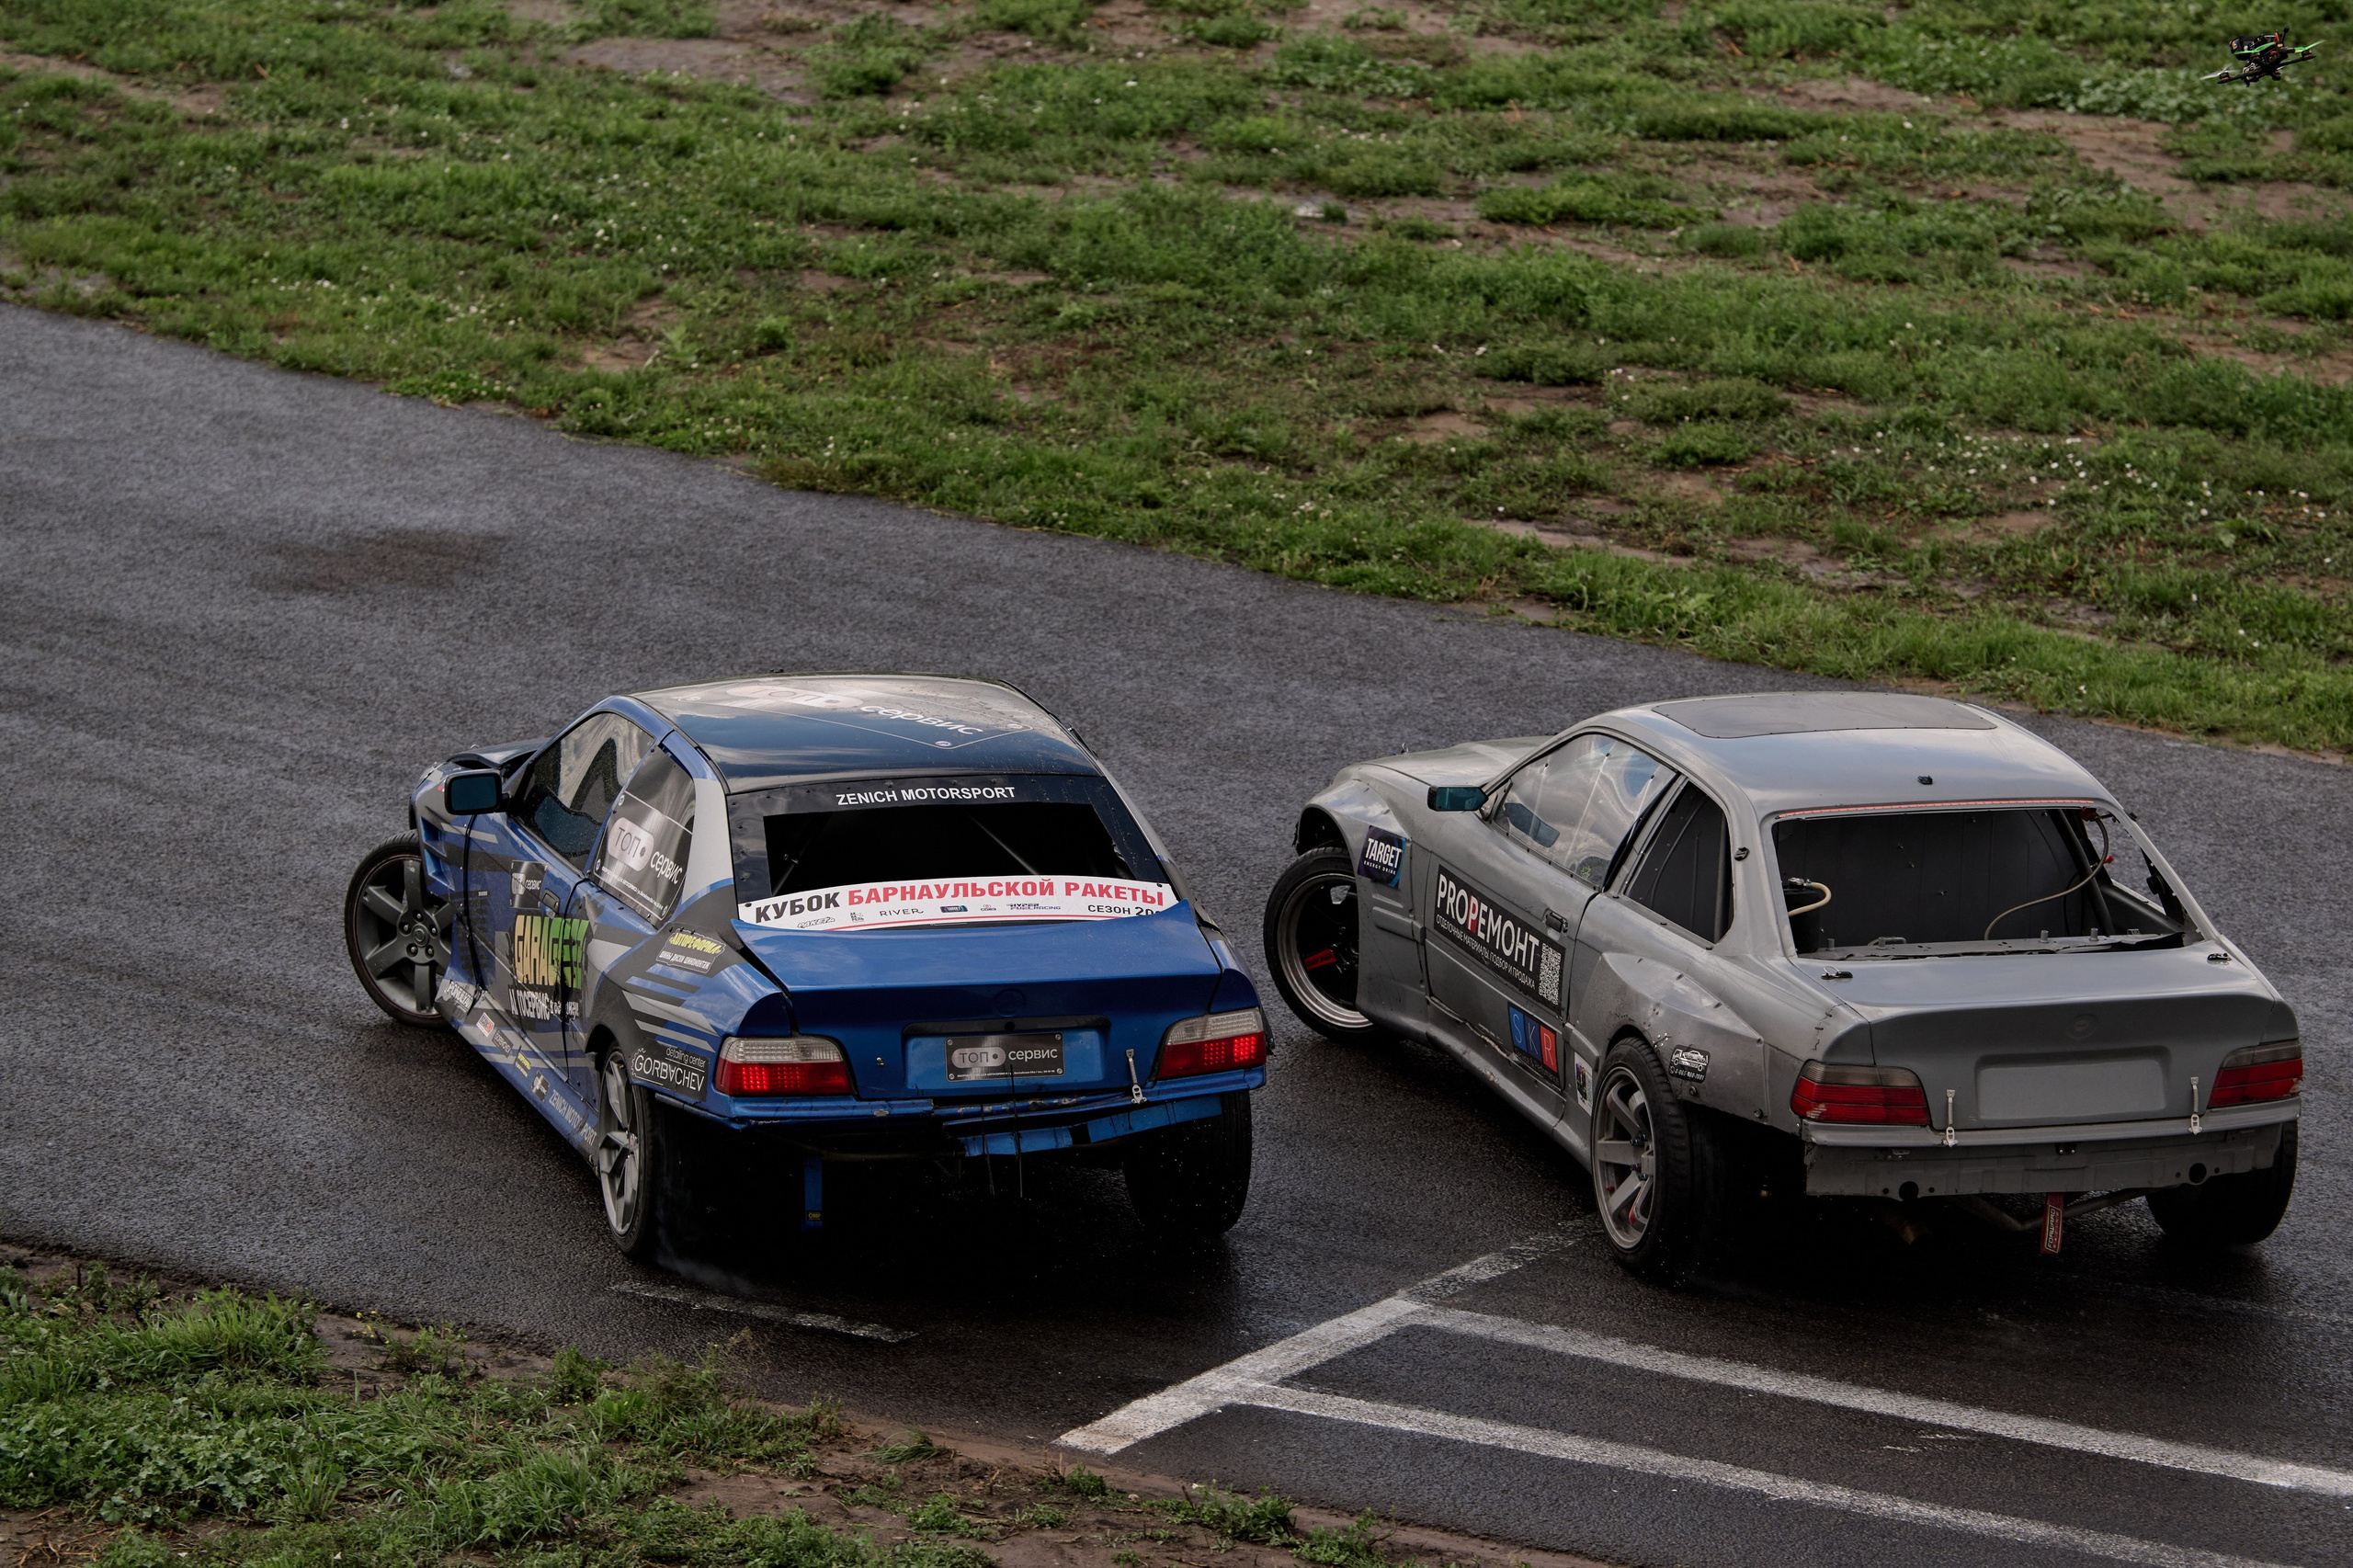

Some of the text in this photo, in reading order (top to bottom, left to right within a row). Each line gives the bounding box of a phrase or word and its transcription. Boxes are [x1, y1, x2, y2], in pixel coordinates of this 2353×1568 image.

[859, 704, 984, 736] сервис
[835, 786, 1016, 806] ZENICH MOTORSPORT
[615, 826, 642, 858] ТОП
[650, 850, 683, 885] сервис
[1365, 837, 1404, 869] TARGET
[1363, 860, 1397, 875] ENERGY DRINK
[755, 878, 1165, 925] КУБОК БАРНАУЛЬСКОЙ РАКЕТЫ
[880, 908, 924, 917] RIVER
[1087, 904, 1131, 915] СЕЗОН
[1512, 965, 1537, 990] ПРОДАЖА
[1513, 1013, 1554, 1066] SKR
[665, 1047, 706, 1068] detailing center
[959, 1048, 1058, 1063] ТОП сервис
[2047, 1208, 2056, 1249] FORWARD
